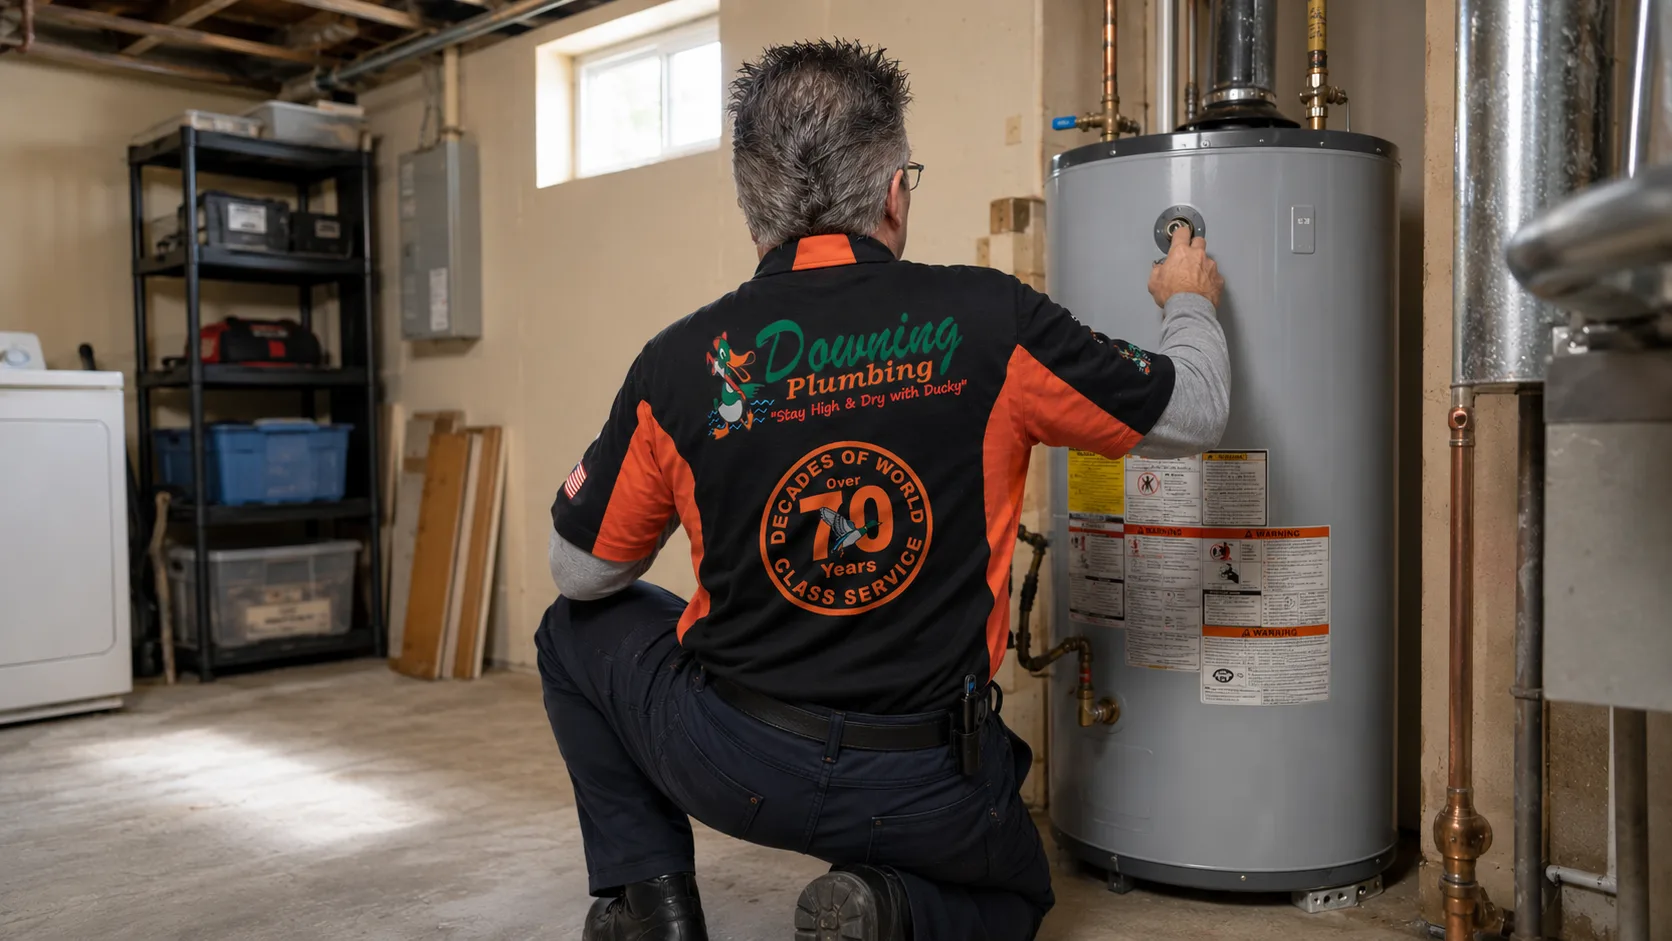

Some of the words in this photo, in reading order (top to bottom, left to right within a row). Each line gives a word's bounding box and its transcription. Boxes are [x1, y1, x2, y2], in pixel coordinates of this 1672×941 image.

[756, 312, 963, 384] Downing
[770, 406, 805, 422] "Stay
[811, 400, 840, 416] High
[845, 397, 856, 409] &
[861, 393, 885, 408] Dry
[890, 386, 919, 402] with
[924, 379, 968, 397] Ducky"
[786, 360, 933, 400] Plumbing
[770, 453, 835, 545] DECADES
[841, 450, 869, 465] OF
[875, 456, 924, 523] WORLD
[826, 476, 861, 490] Over
[799, 485, 894, 561] 70
[774, 558, 836, 605] CLASS
[844, 536, 922, 605] SERVICE
[820, 560, 877, 579] Years
